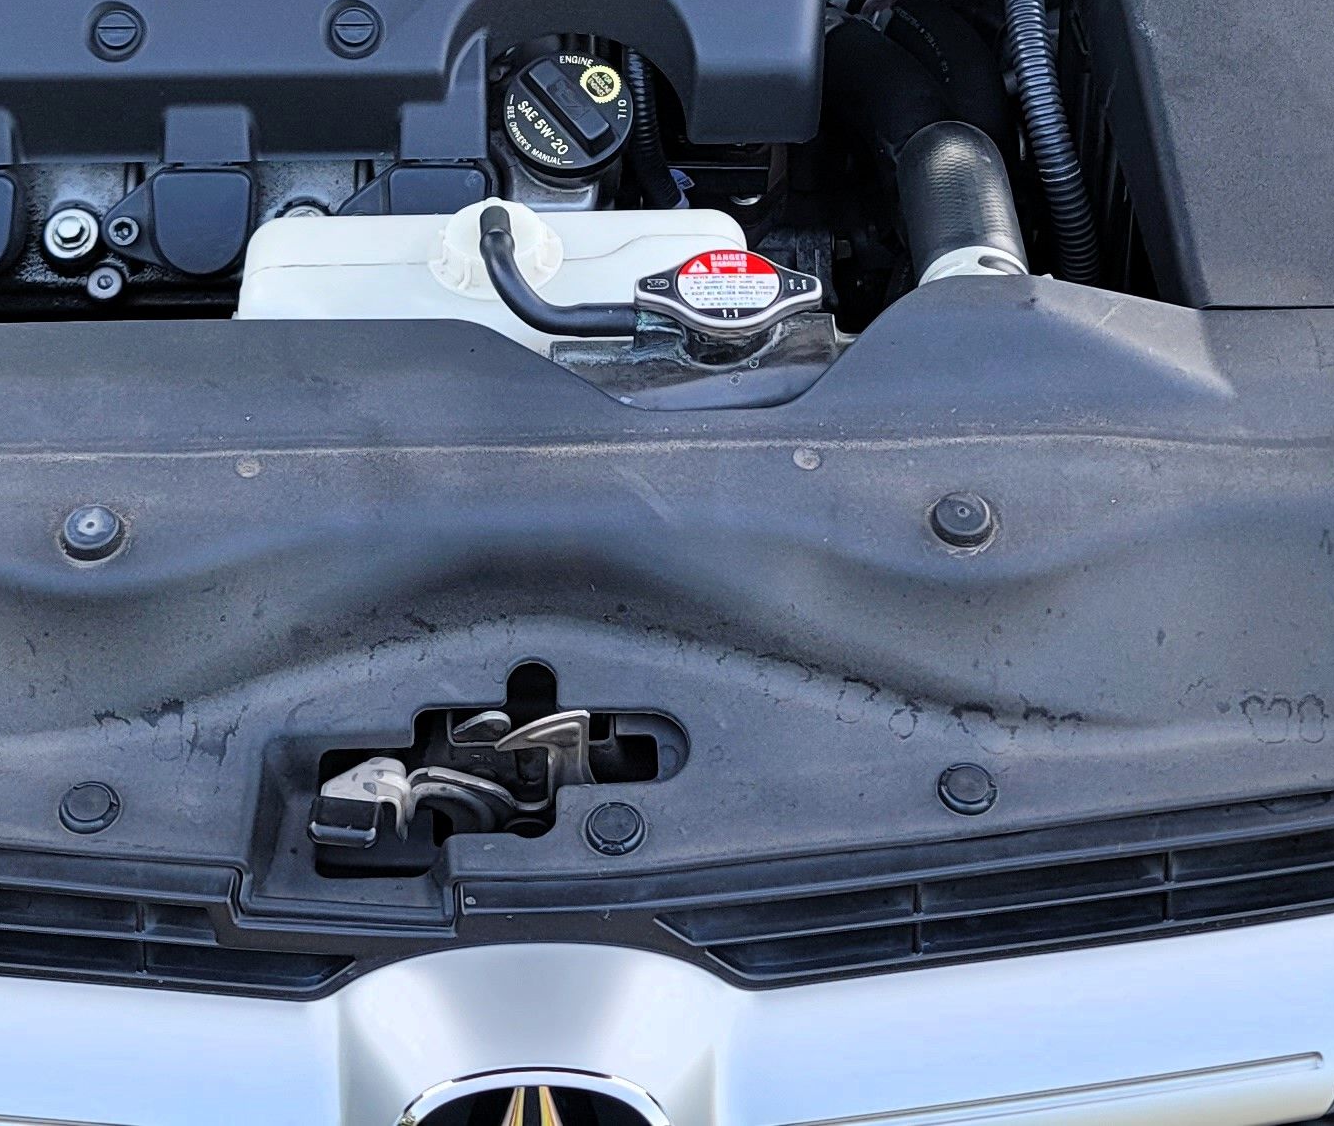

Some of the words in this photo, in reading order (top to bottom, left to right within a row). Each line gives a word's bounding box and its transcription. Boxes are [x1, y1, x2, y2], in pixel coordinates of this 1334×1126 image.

[559, 55, 594, 68] ENGINE
[617, 99, 628, 121] OIL
[506, 105, 516, 120] SEE
[531, 148, 562, 166] MANUAL
[517, 100, 539, 122] SAE
[534, 118, 569, 155] 5W-20
[710, 253, 748, 261] DANGER
[789, 278, 807, 291] 1.1
[721, 309, 739, 318] 1.1
